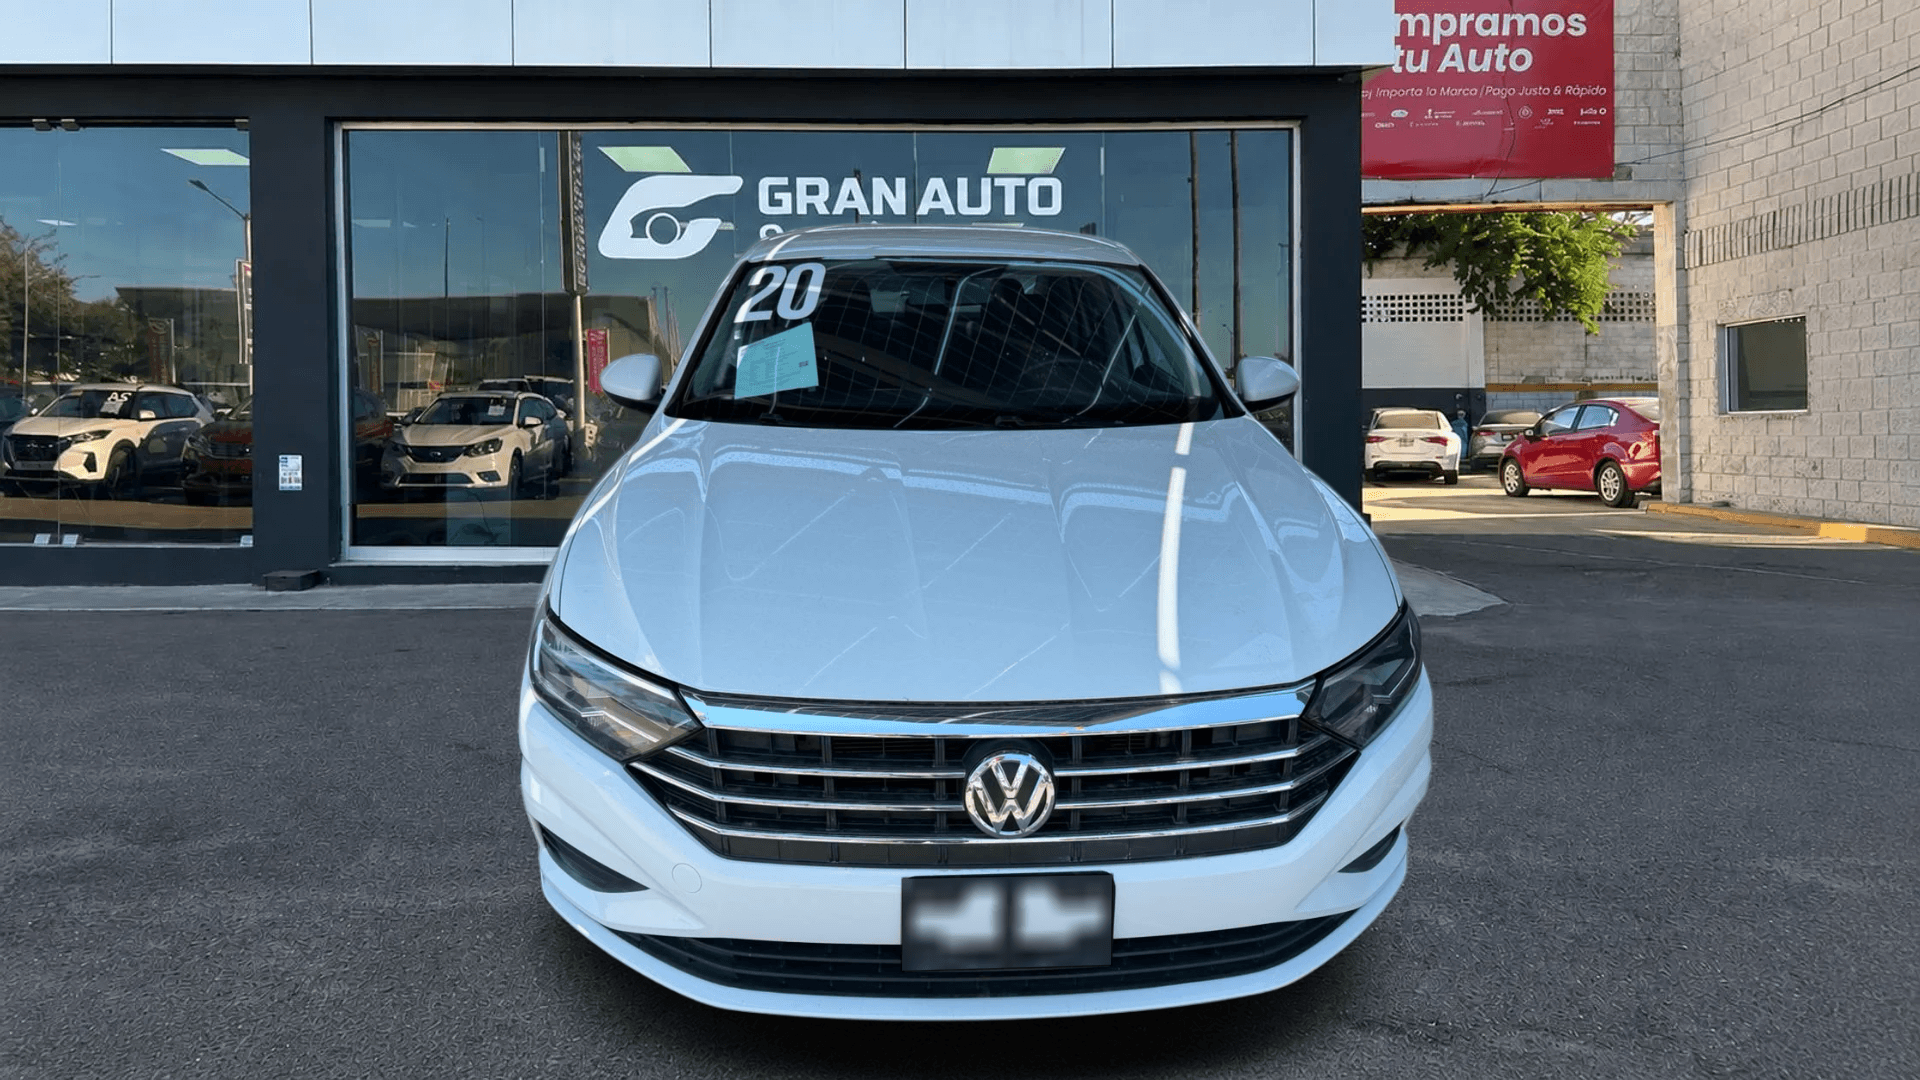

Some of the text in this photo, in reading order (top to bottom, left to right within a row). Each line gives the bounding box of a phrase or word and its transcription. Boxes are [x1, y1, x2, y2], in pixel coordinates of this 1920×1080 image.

[1391, 42, 1533, 74] tu Auto
[1376, 87, 1423, 99] Importa
[1426, 87, 1437, 96] la
[1440, 86, 1478, 96] Marca
[1519, 86, 1551, 96] Justo
[1553, 86, 1562, 95] &
[758, 176, 1062, 216] GRAN AUTO
[733, 262, 827, 323] 20
